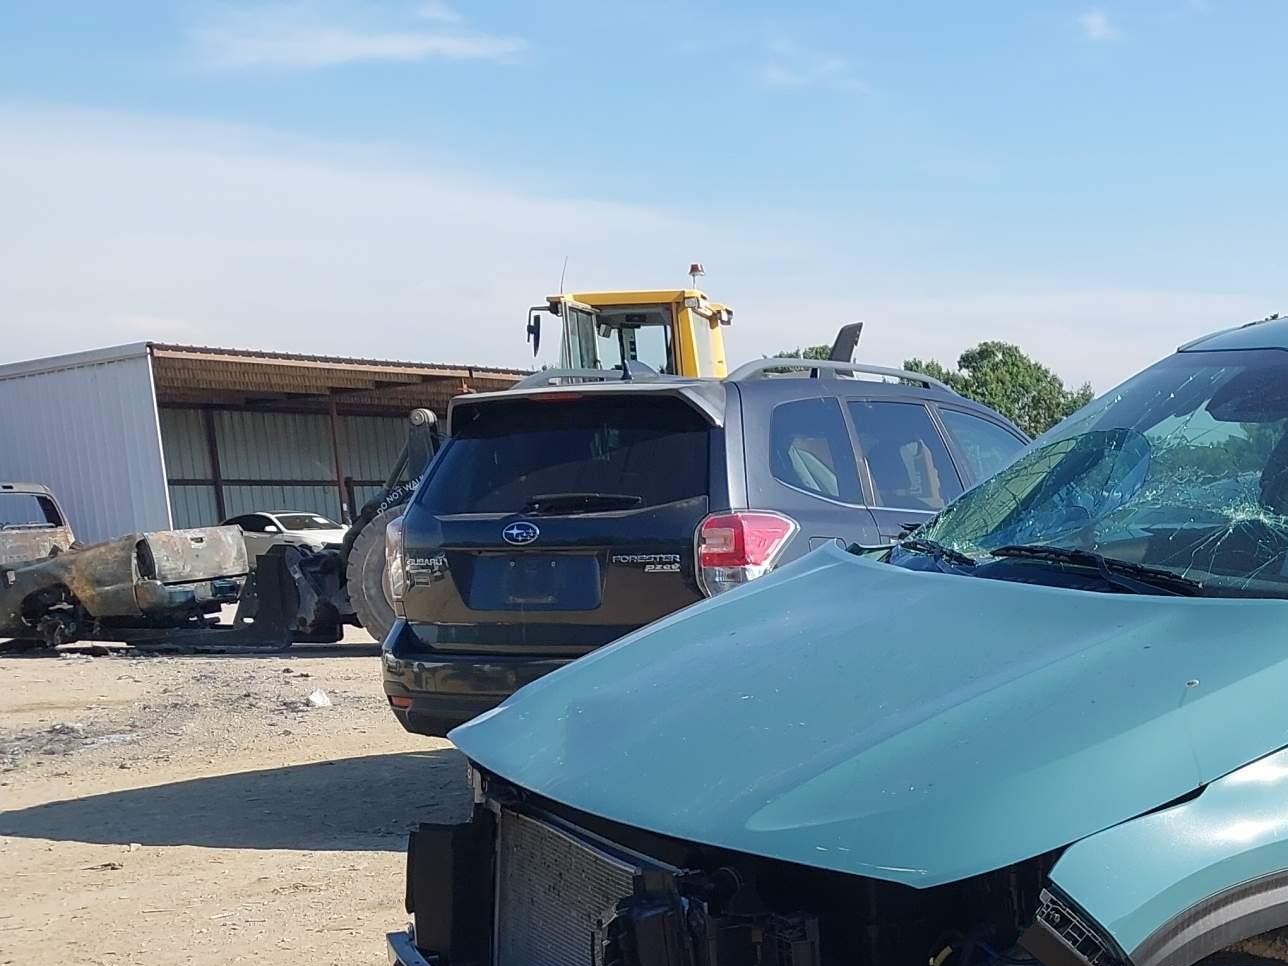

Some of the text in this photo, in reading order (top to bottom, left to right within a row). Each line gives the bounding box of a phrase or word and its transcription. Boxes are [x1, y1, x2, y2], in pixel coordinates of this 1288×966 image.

[386, 488, 403, 504] NOT
[406, 558, 443, 566] SUBARU
[612, 553, 681, 563] FORESTER
